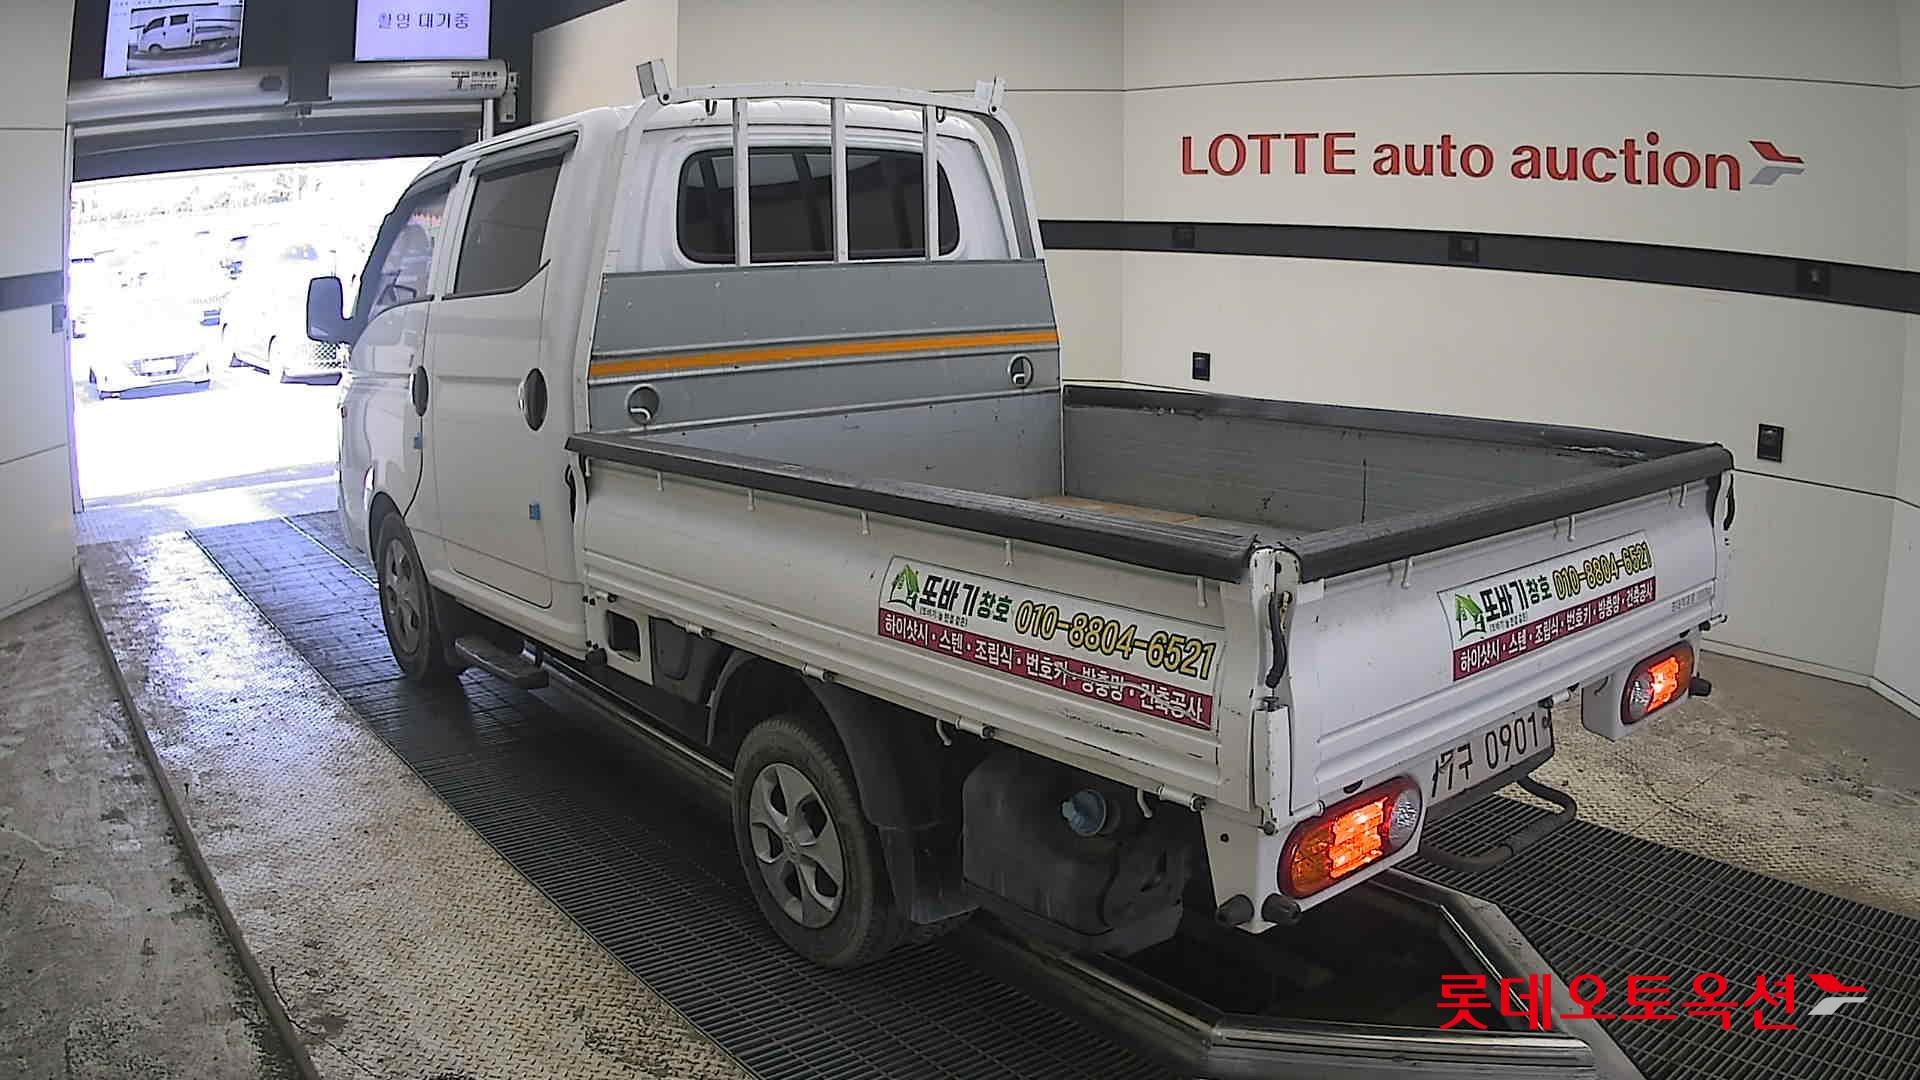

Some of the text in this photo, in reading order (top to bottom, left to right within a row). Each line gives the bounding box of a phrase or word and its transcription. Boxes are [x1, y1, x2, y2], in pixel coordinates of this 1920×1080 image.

[1181, 131, 1741, 191] LOTTE auto auction
[1552, 540, 1654, 600] 010-8804-6521
[884, 613, 930, 646] 하이샷시
[975, 639, 1014, 670] 조립식
[1015, 600, 1217, 680] 010-8804-6521
[1460, 632, 1500, 673] 하이샷시
[1566, 606, 1592, 632] 번호키
[1485, 712, 1538, 769] 0901
